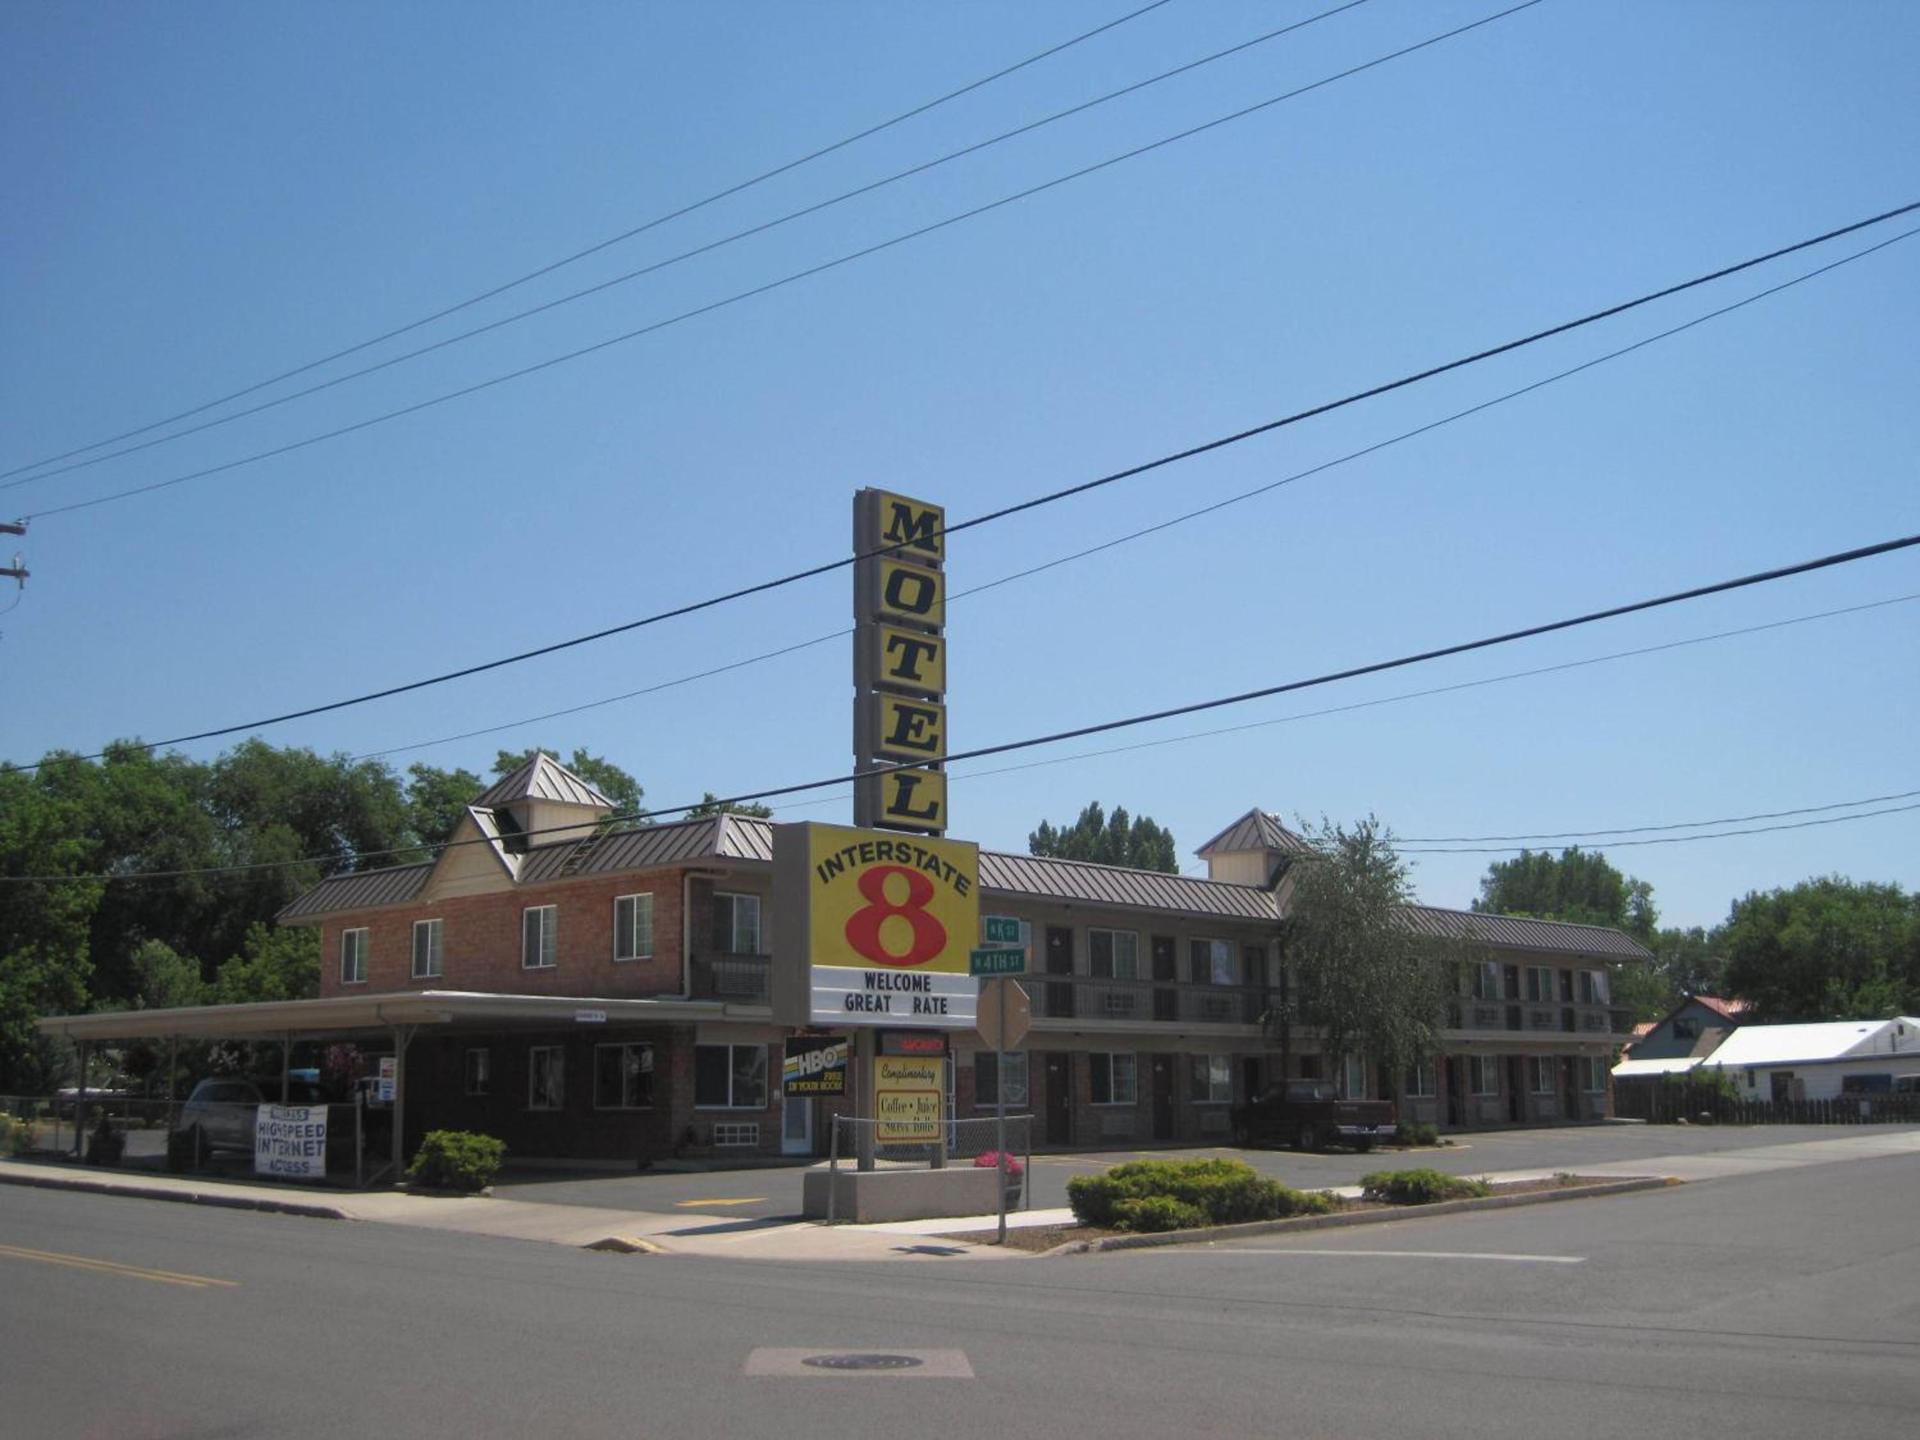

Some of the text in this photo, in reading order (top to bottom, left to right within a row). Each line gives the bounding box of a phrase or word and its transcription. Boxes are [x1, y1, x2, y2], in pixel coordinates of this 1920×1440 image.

[883, 501, 939, 821] MOTEL
[817, 840, 972, 897] INTERSTATE
[844, 865, 947, 967] 8
[864, 972, 931, 992] WELCOME
[845, 995, 948, 1014] GREAT RATE
[799, 1047, 837, 1076] HBO
[881, 1097, 908, 1113] Coffee
[258, 1138, 325, 1156] INTERNET
[270, 1159, 309, 1174] ACCESS
